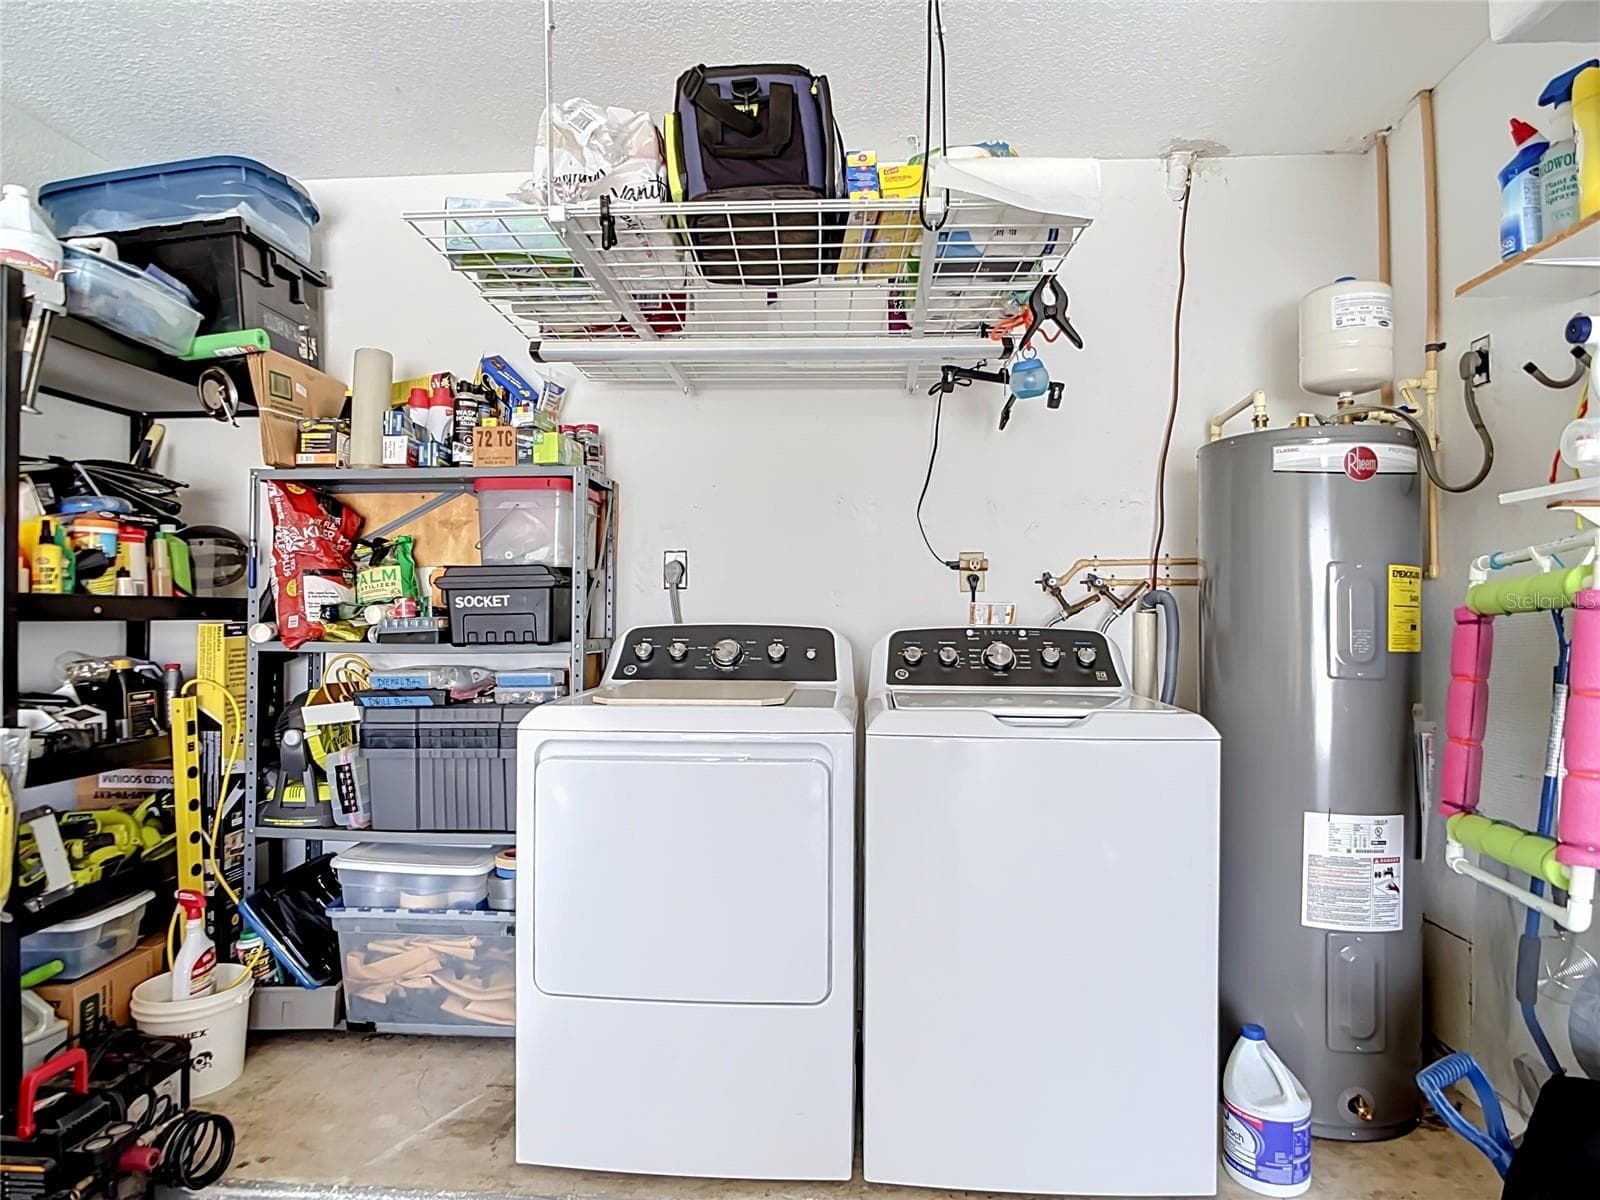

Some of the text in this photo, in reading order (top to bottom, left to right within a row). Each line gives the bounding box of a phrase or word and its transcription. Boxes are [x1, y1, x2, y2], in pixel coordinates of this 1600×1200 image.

[477, 430, 513, 448] 72 TC
[1347, 448, 1377, 475] Rheem
[455, 594, 511, 609] SOCKET
